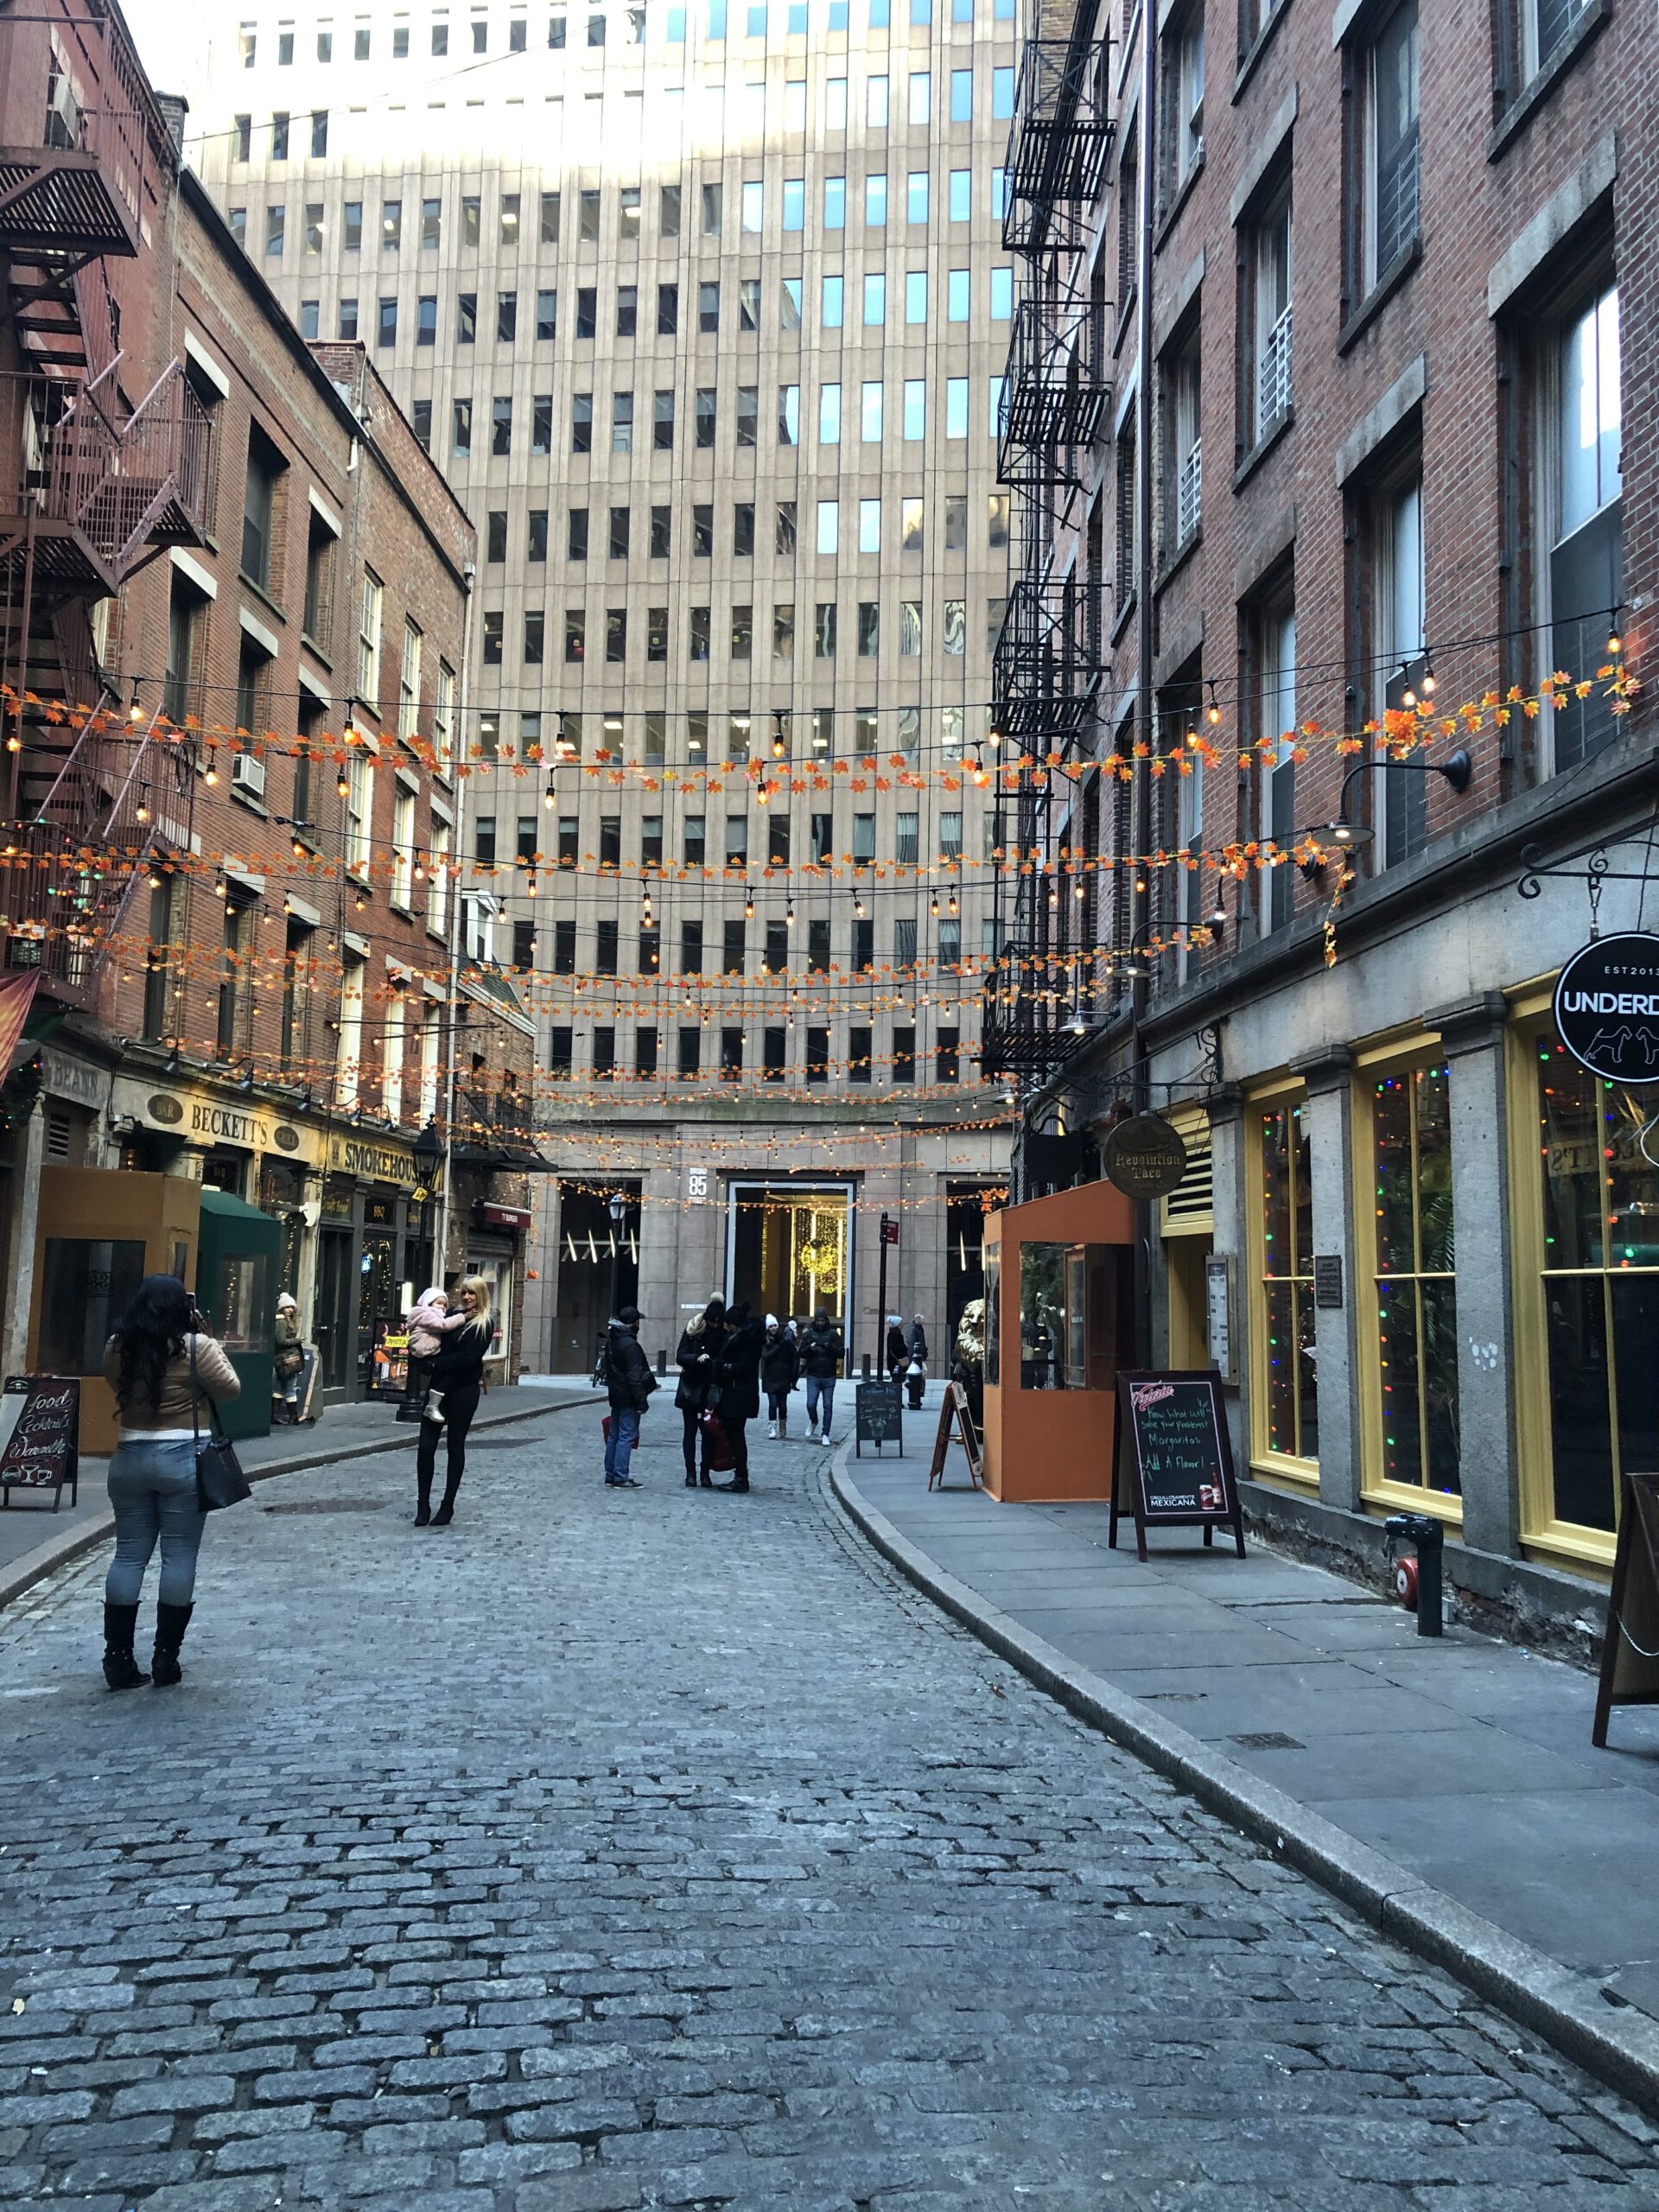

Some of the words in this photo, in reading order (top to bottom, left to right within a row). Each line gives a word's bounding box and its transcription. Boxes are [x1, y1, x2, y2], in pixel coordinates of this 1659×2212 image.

[1564, 991, 1659, 1015] UNDERD
[191, 1104, 268, 1146] BECKETT'S
[1115, 1153, 1180, 1168] Revolution
[1131, 1166, 1161, 1179] Taco
[689, 1175, 708, 1196] 85
[1147, 1433, 1201, 1452] Margaritas
[1145, 1453, 1160, 1470] Add
[1166, 1455, 1173, 1468] A
[1150, 1498, 1197, 1507] MEXICANA
